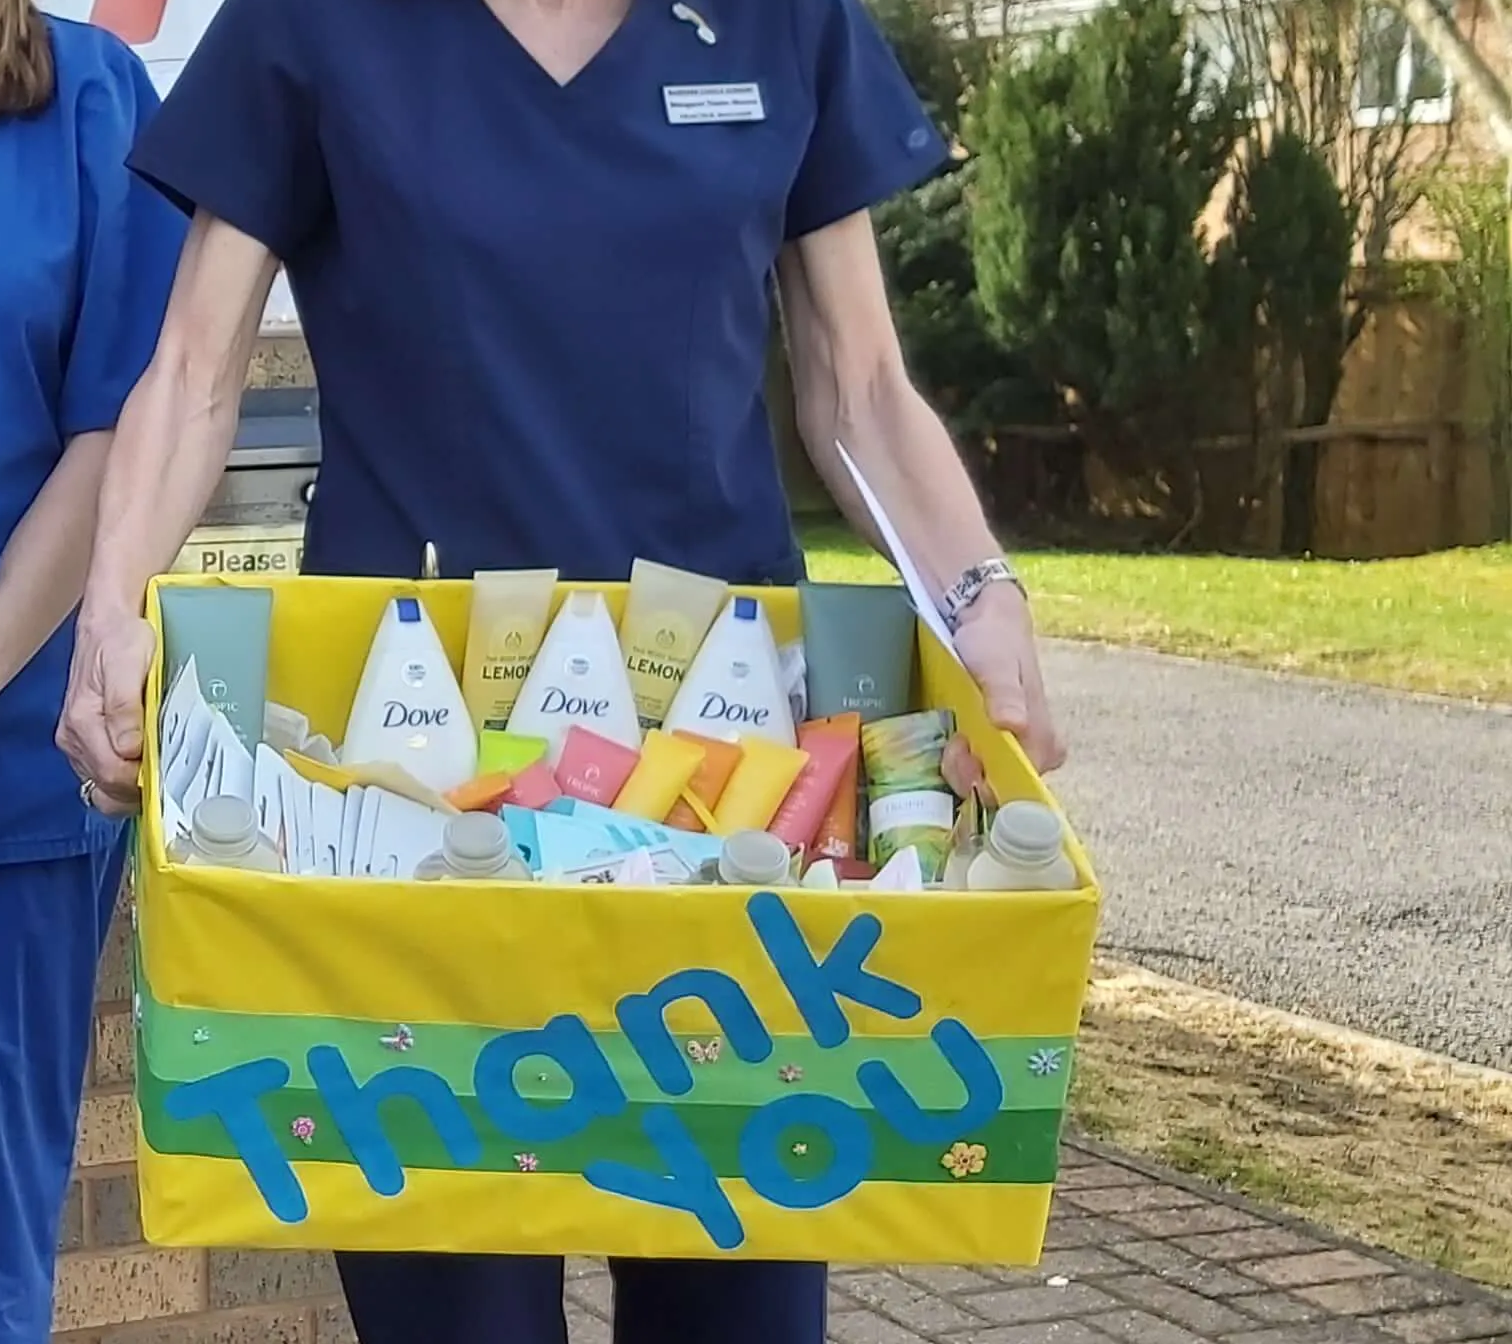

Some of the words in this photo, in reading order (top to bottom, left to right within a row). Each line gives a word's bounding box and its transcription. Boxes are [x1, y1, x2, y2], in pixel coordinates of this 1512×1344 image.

[201, 549, 287, 574] Please
[626, 655, 686, 682] LEMON
[382, 700, 450, 728] Dove
[540, 685, 610, 717] Dove
[699, 691, 769, 727] Dove
[163, 891, 922, 1223] Thank
